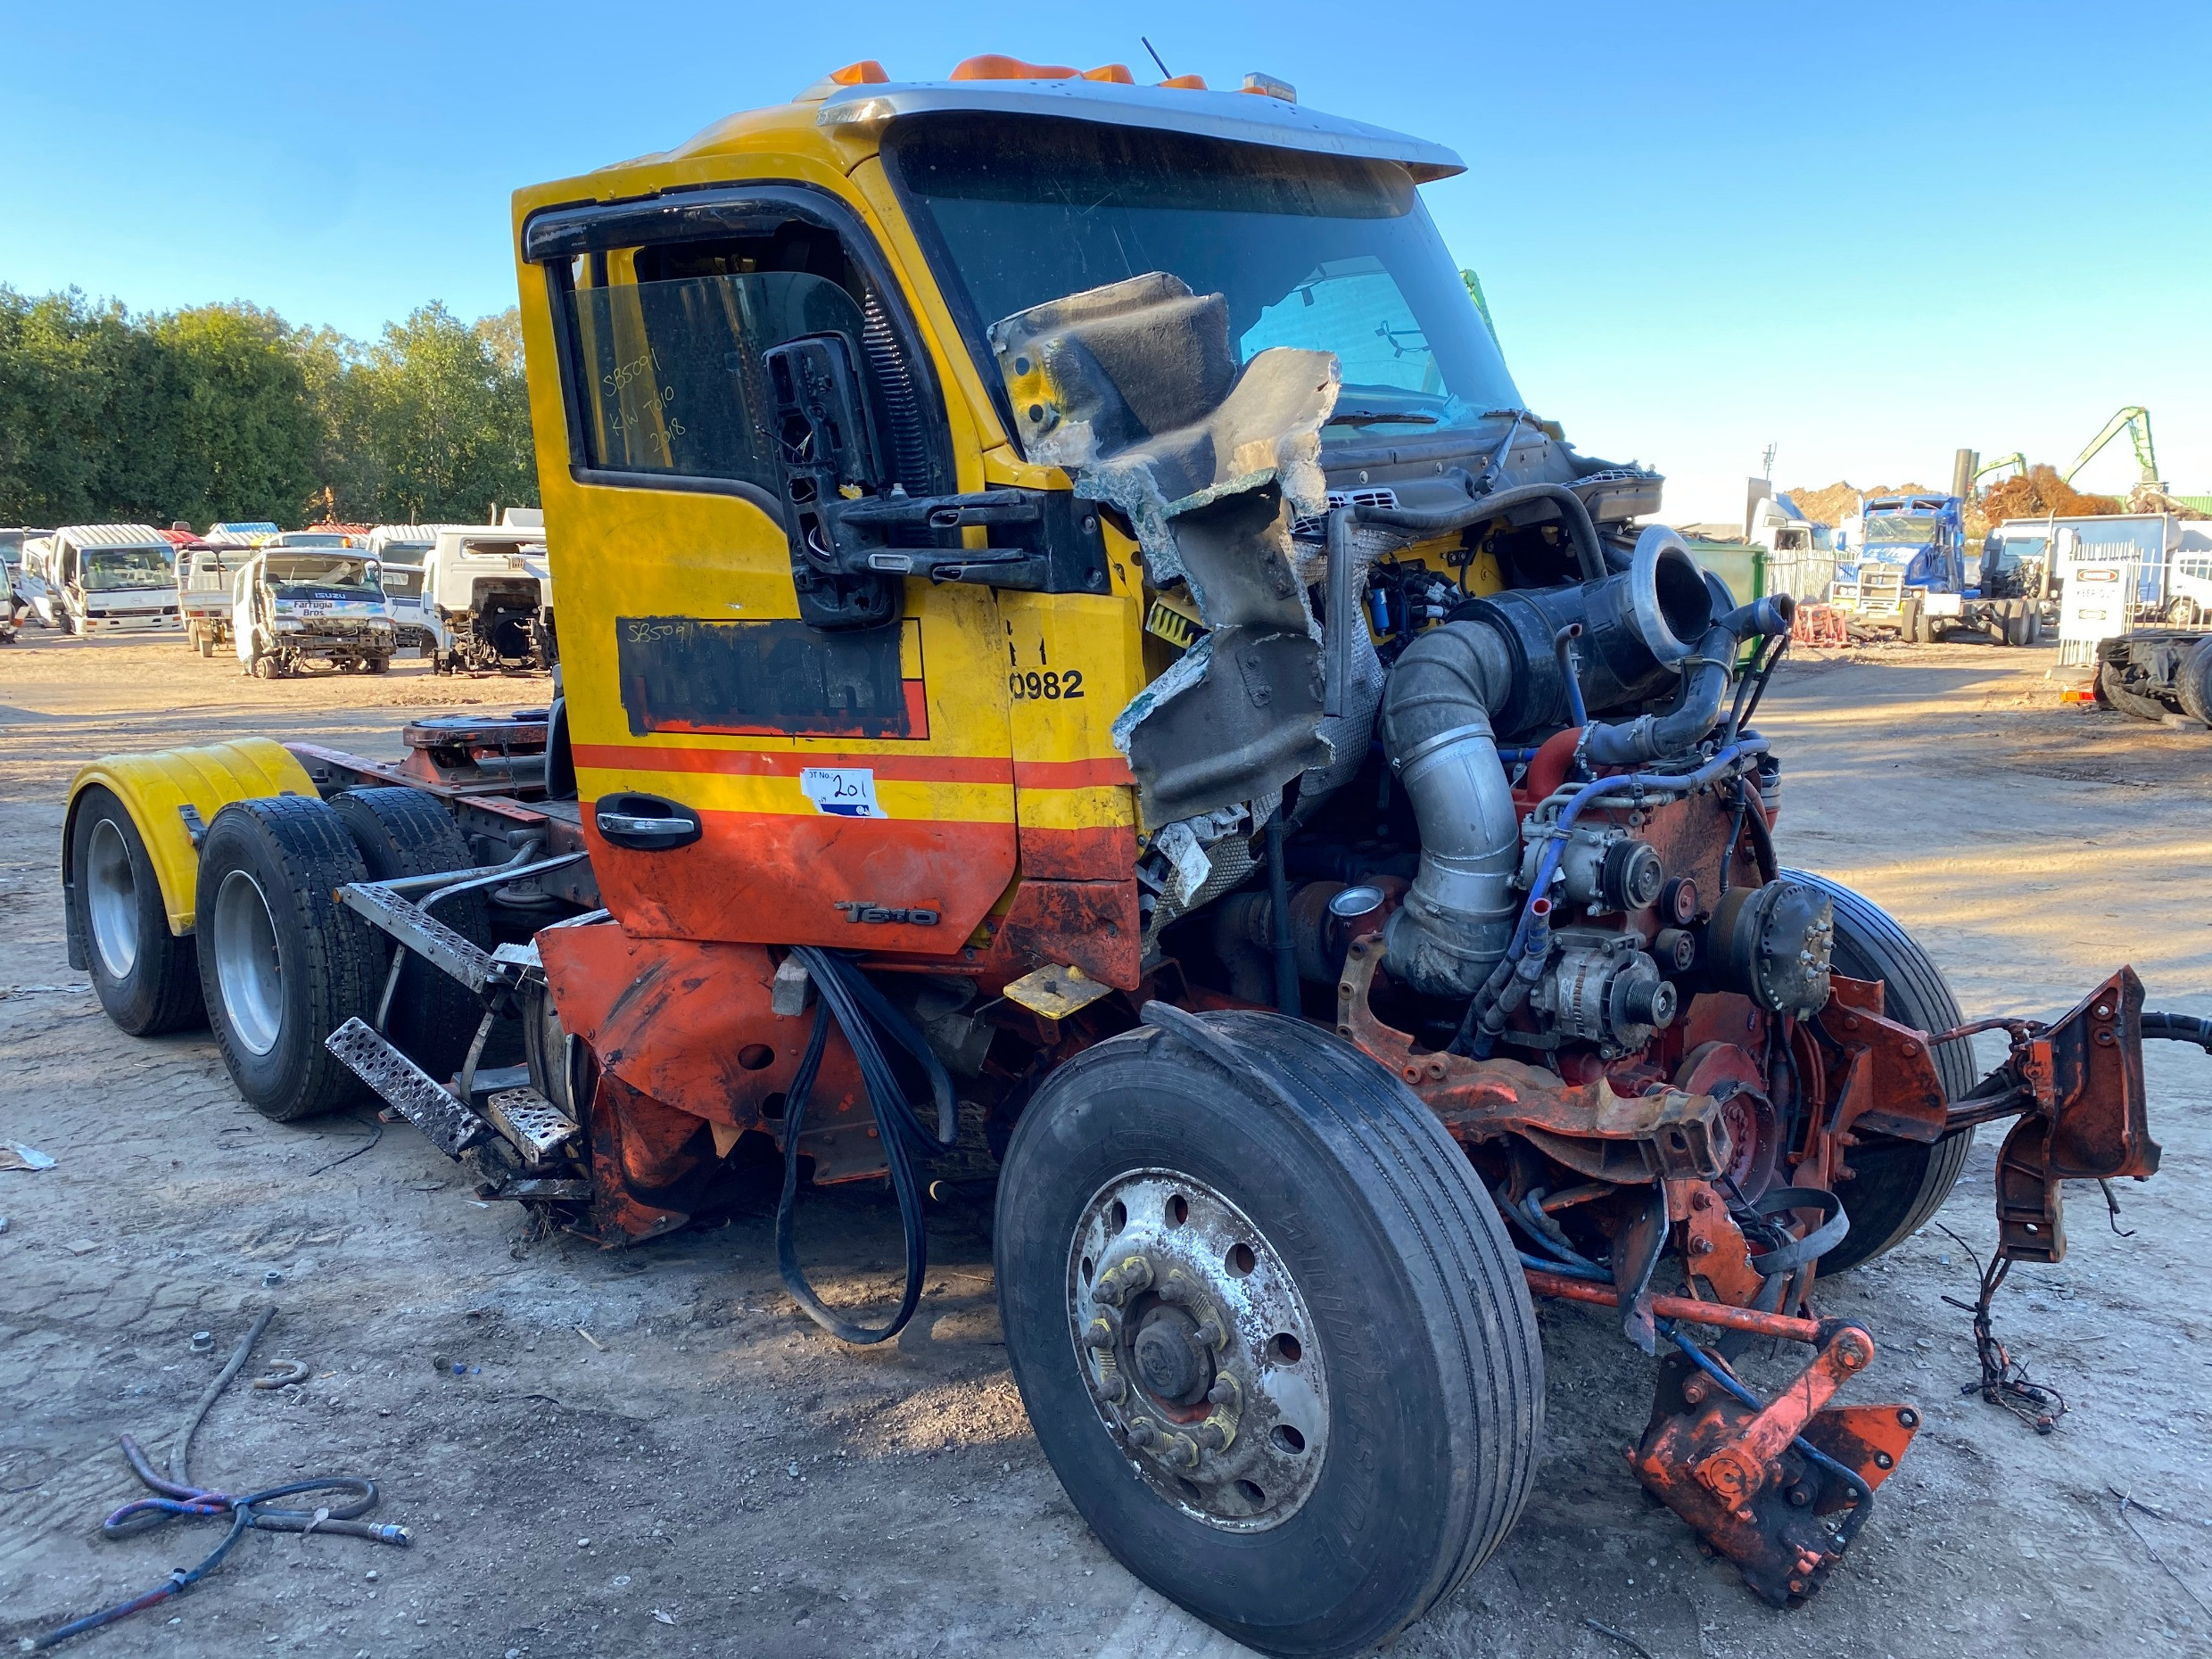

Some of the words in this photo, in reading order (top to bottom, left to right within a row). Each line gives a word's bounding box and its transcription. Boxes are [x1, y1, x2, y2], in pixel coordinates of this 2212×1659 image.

[603, 347, 662, 397] SB5091
[643, 385, 674, 417] T610
[649, 417, 686, 453] 2018
[293, 600, 333, 609] Farrugia
[2076, 589, 2096, 598] EEP
[627, 622, 695, 644] SB5091
[1009, 670, 1085, 700] 0982
[832, 774, 867, 798] 201
